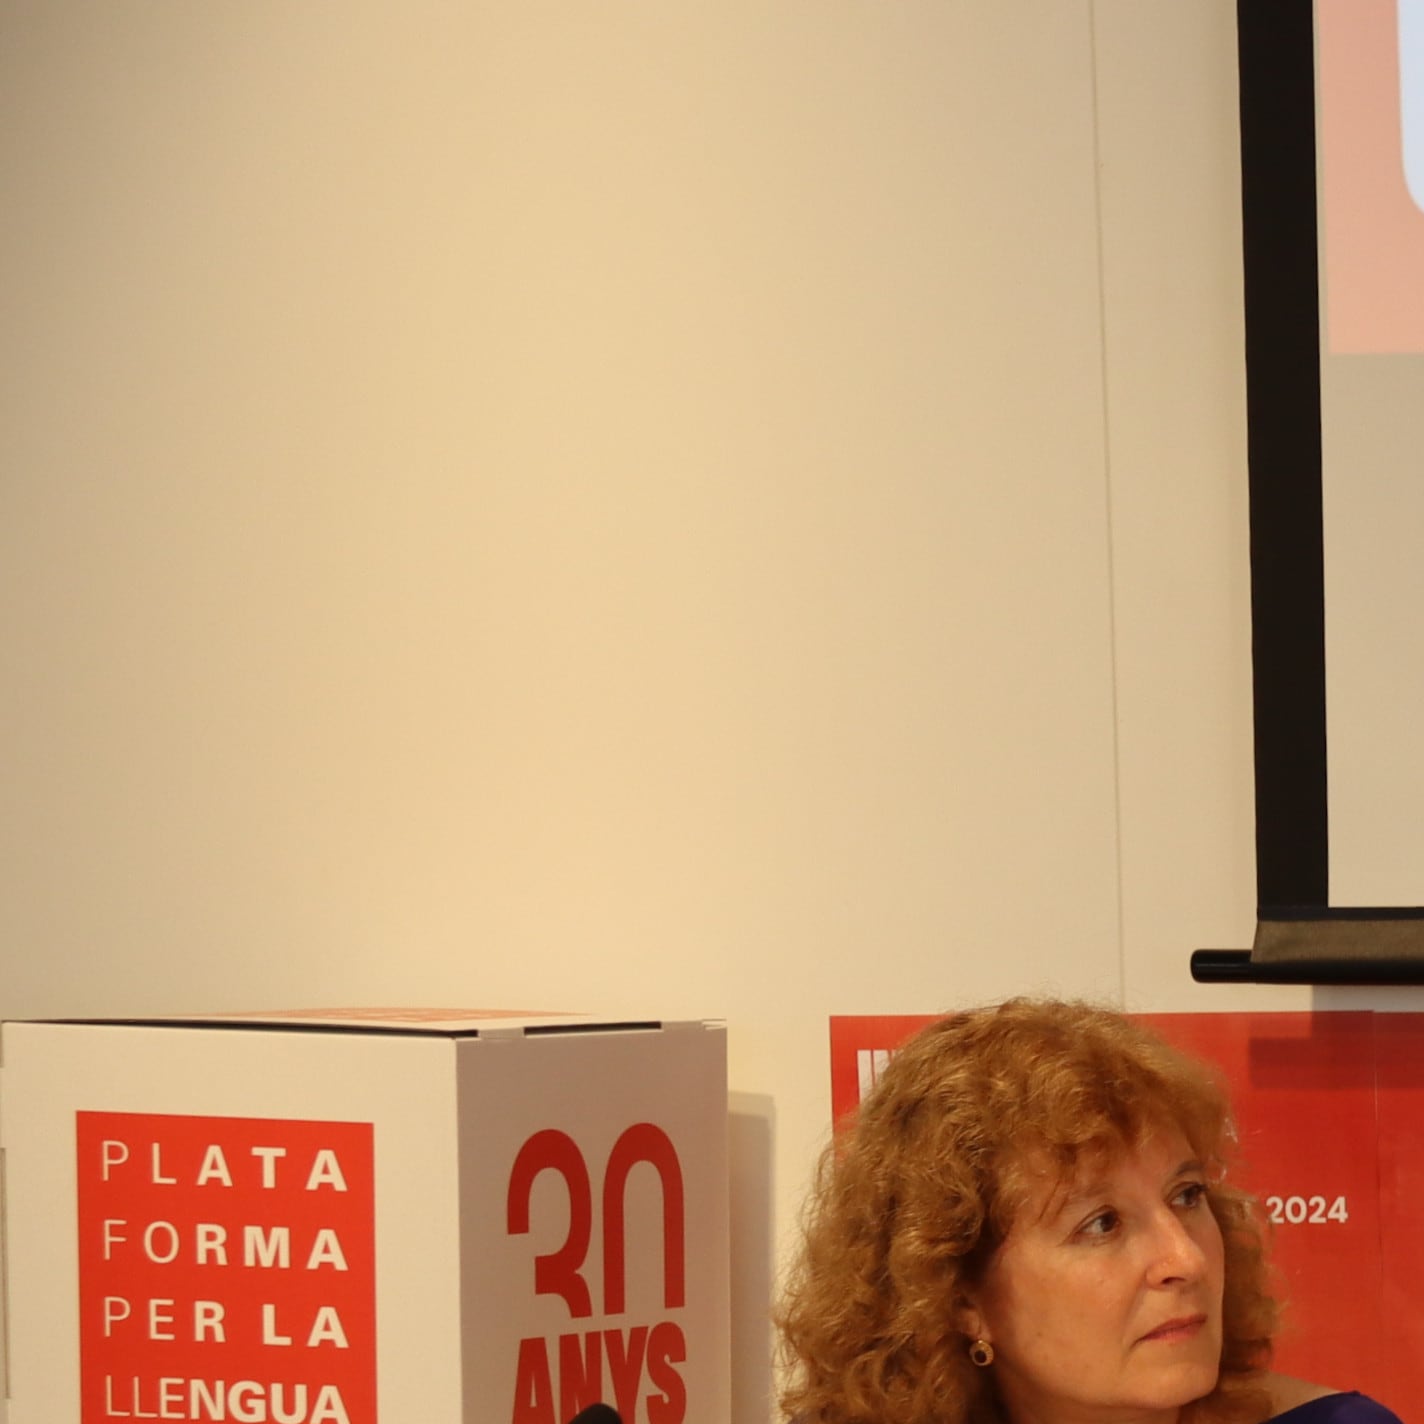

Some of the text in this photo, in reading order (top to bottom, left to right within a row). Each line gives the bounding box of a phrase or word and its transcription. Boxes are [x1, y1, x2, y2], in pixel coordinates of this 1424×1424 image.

[101, 1140, 348, 1192] PLATA
[506, 1122, 686, 1319] 30
[1266, 1195, 1349, 1225] 2024
[103, 1219, 349, 1272] FORMA
[103, 1296, 350, 1348] PER LA
